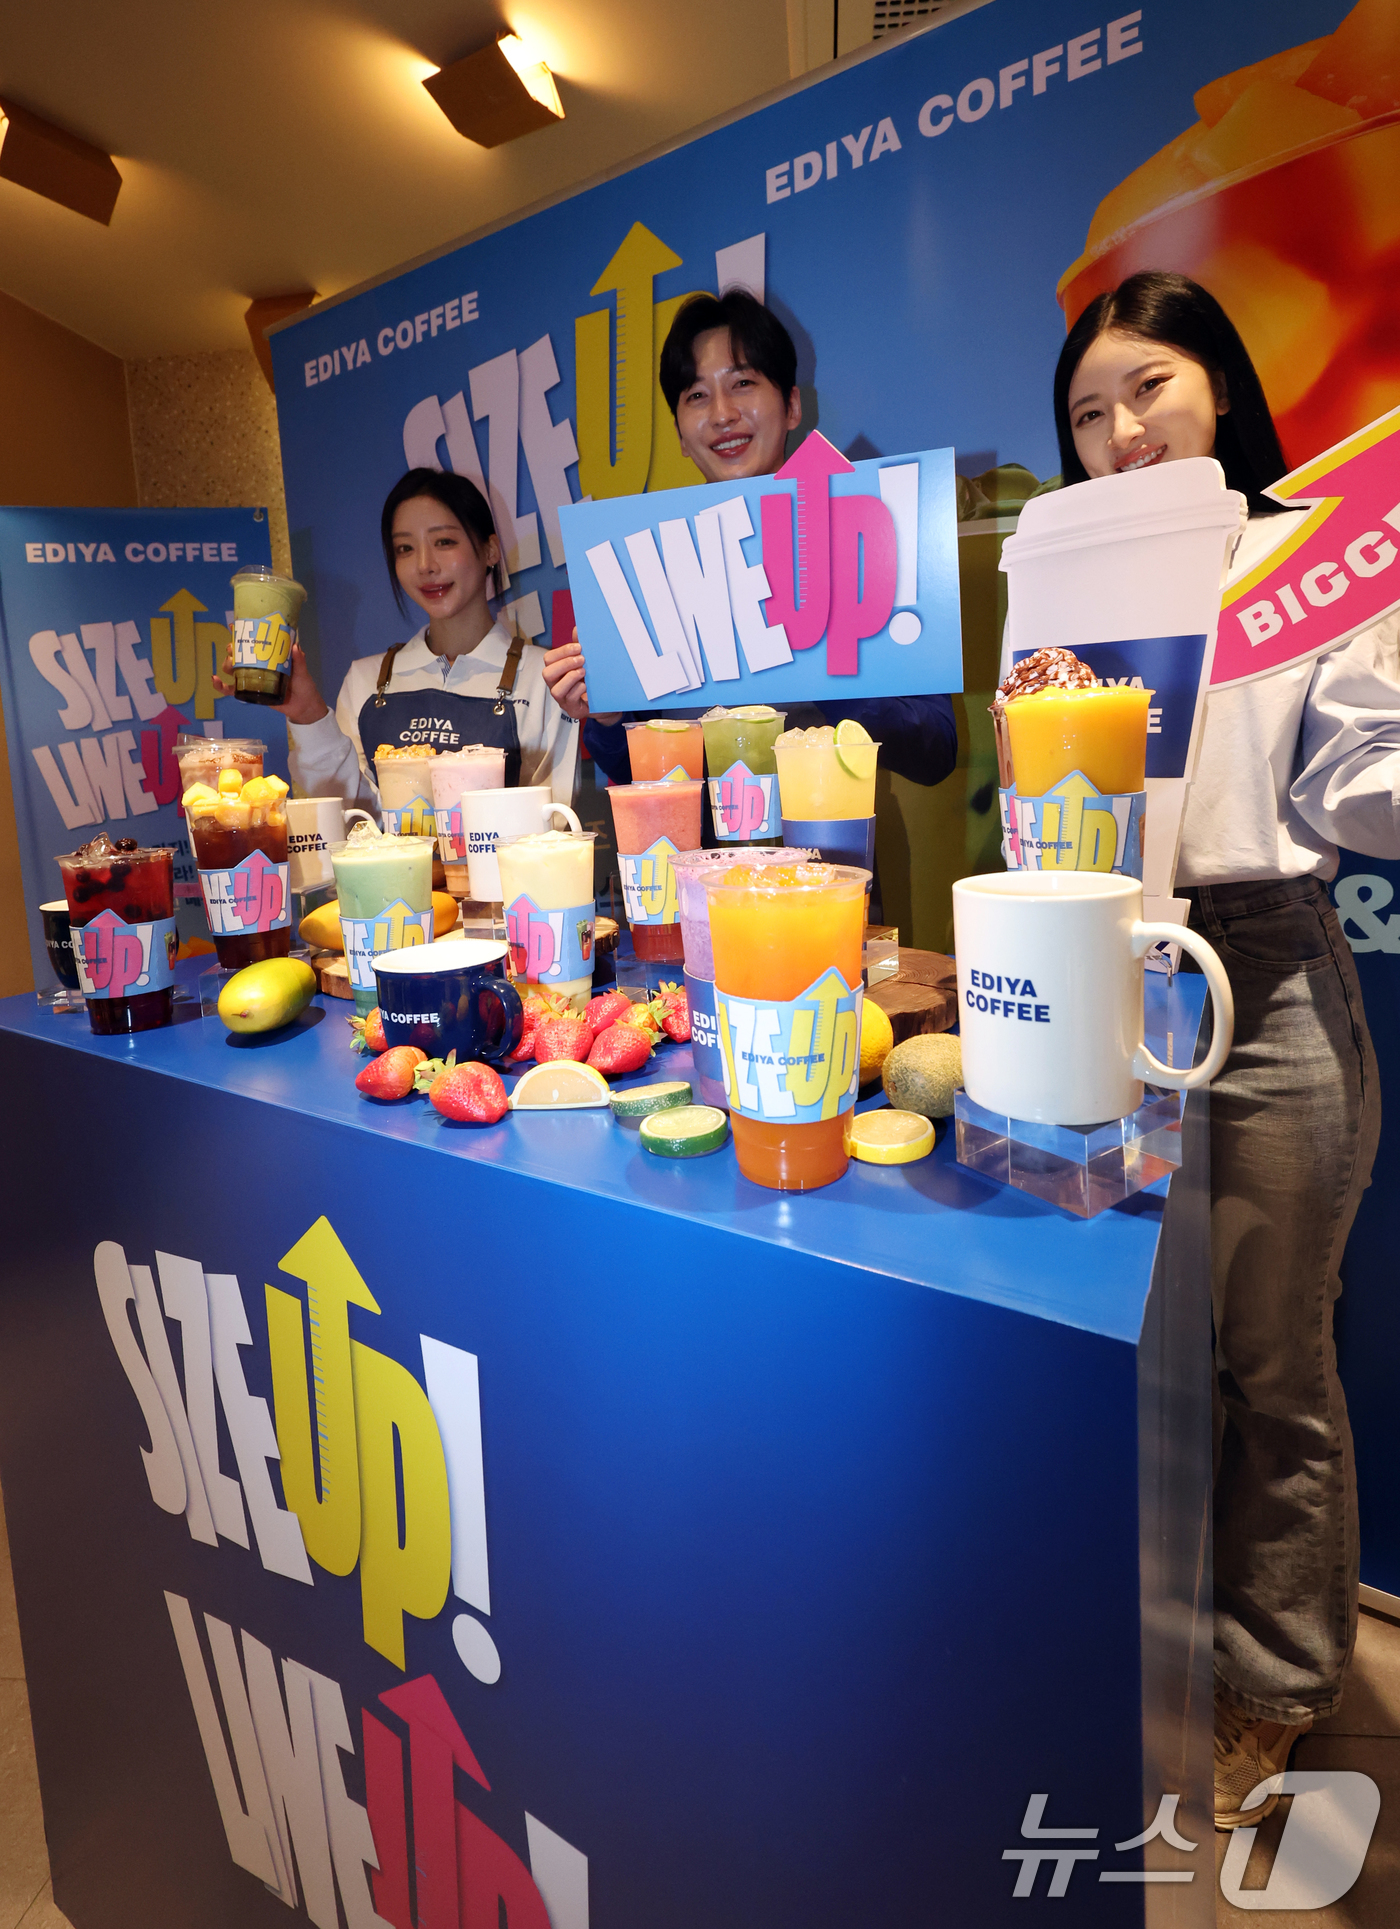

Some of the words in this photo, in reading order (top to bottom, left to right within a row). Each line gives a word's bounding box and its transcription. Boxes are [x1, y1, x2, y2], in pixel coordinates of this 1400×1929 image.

[765, 116, 902, 205] EDIYA
[917, 9, 1143, 138] COFFEE
[304, 333, 372, 388] EDIYA
[376, 290, 479, 357] COFFEE
[25, 542, 116, 564] EDIYA
[125, 542, 239, 563] COFFEE
[1236, 502, 1400, 648] BIGG
[28, 620, 169, 732] SIZE
[409, 717, 453, 731] EDIYA
[399, 730, 460, 745] COFFEE
[288, 833, 323, 844] EDIYA
[469, 831, 500, 842] EDIYA
[1035, 841, 1073, 850] COFFEE
[468, 844, 497, 853] COFFE
[970, 968, 1038, 998] EDIYA
[966, 989, 1050, 1023] COFFEE
[390, 1011, 440, 1025] COFFEE
[692, 1009, 717, 1031] EDI
[691, 1025, 720, 1050] COF
[742, 1051, 775, 1065] EDIYA
[778, 1052, 826, 1066] COFFEE
[93, 1240, 314, 1587] SIZE
